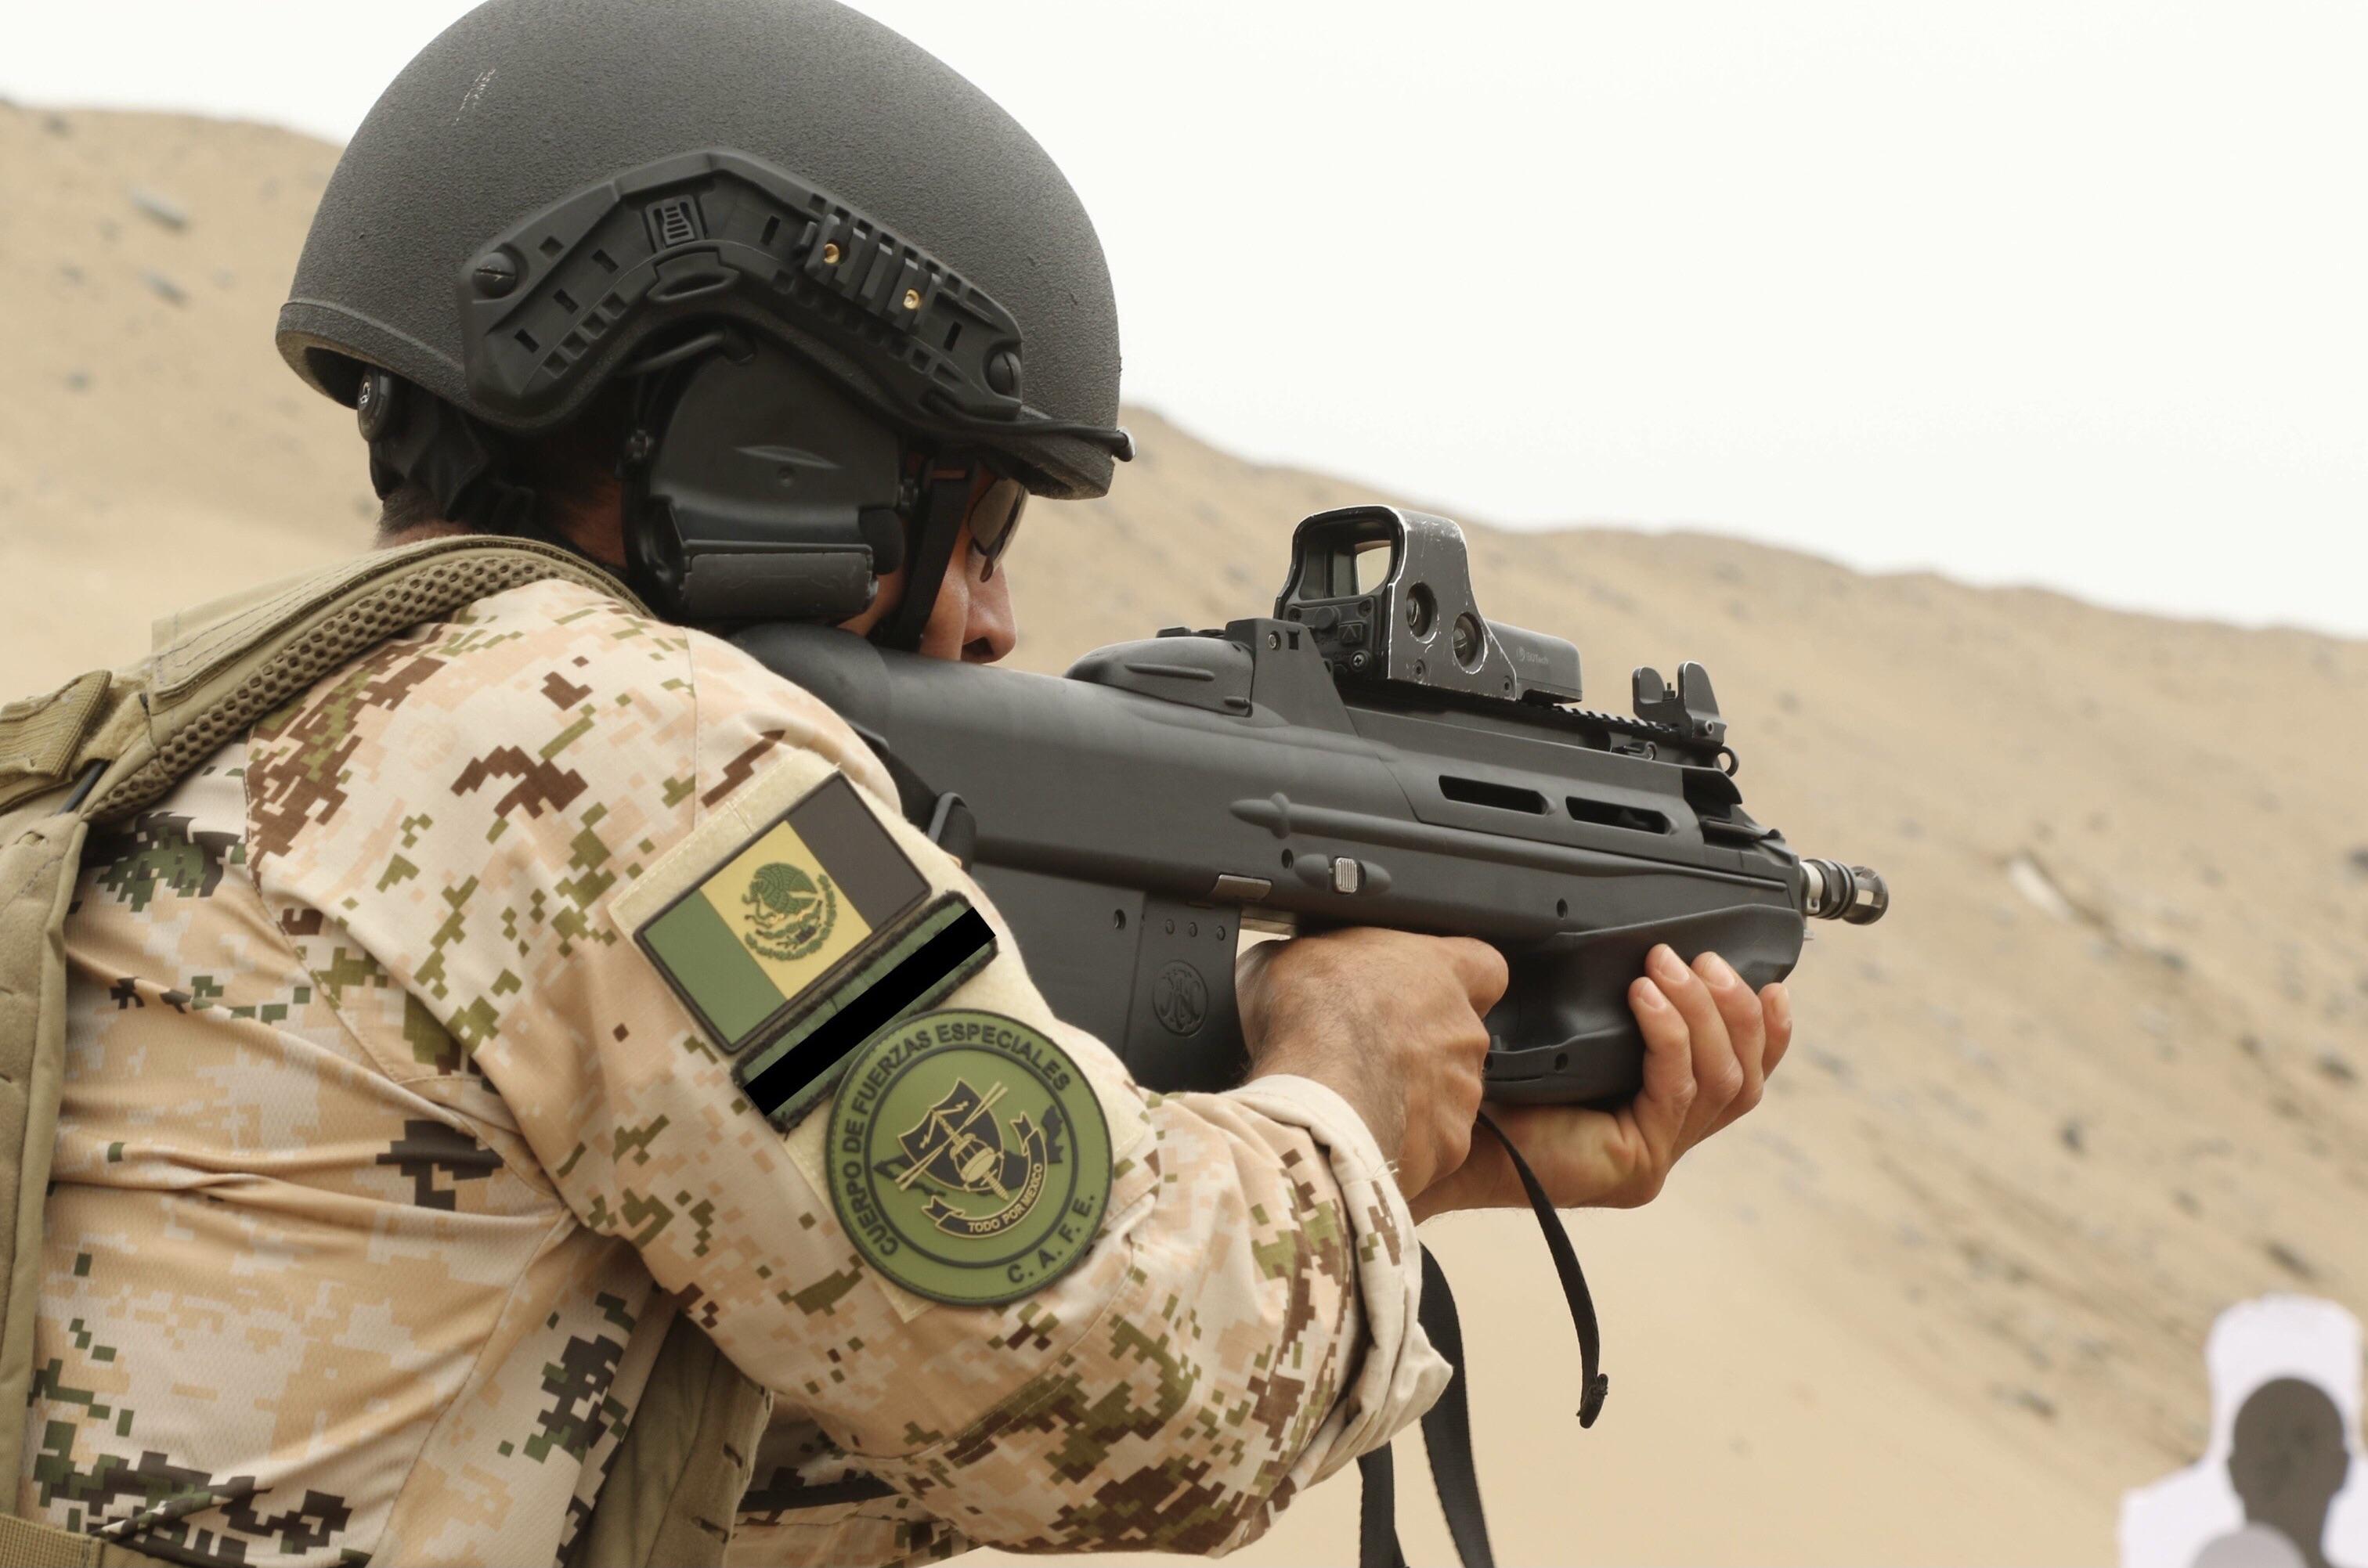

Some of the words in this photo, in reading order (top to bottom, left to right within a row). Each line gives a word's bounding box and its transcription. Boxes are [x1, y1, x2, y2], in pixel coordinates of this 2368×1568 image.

[851, 1029, 933, 1115] FUERZAS
[935, 1022, 1070, 1092] ESPECIALES
[843, 1119, 865, 1153] DE
[842, 1162, 899, 1256] CUERPO
[967, 1219, 1001, 1234] TODO
[1002, 1204, 1026, 1224] POR
[1020, 1162, 1043, 1208] MEXICO
